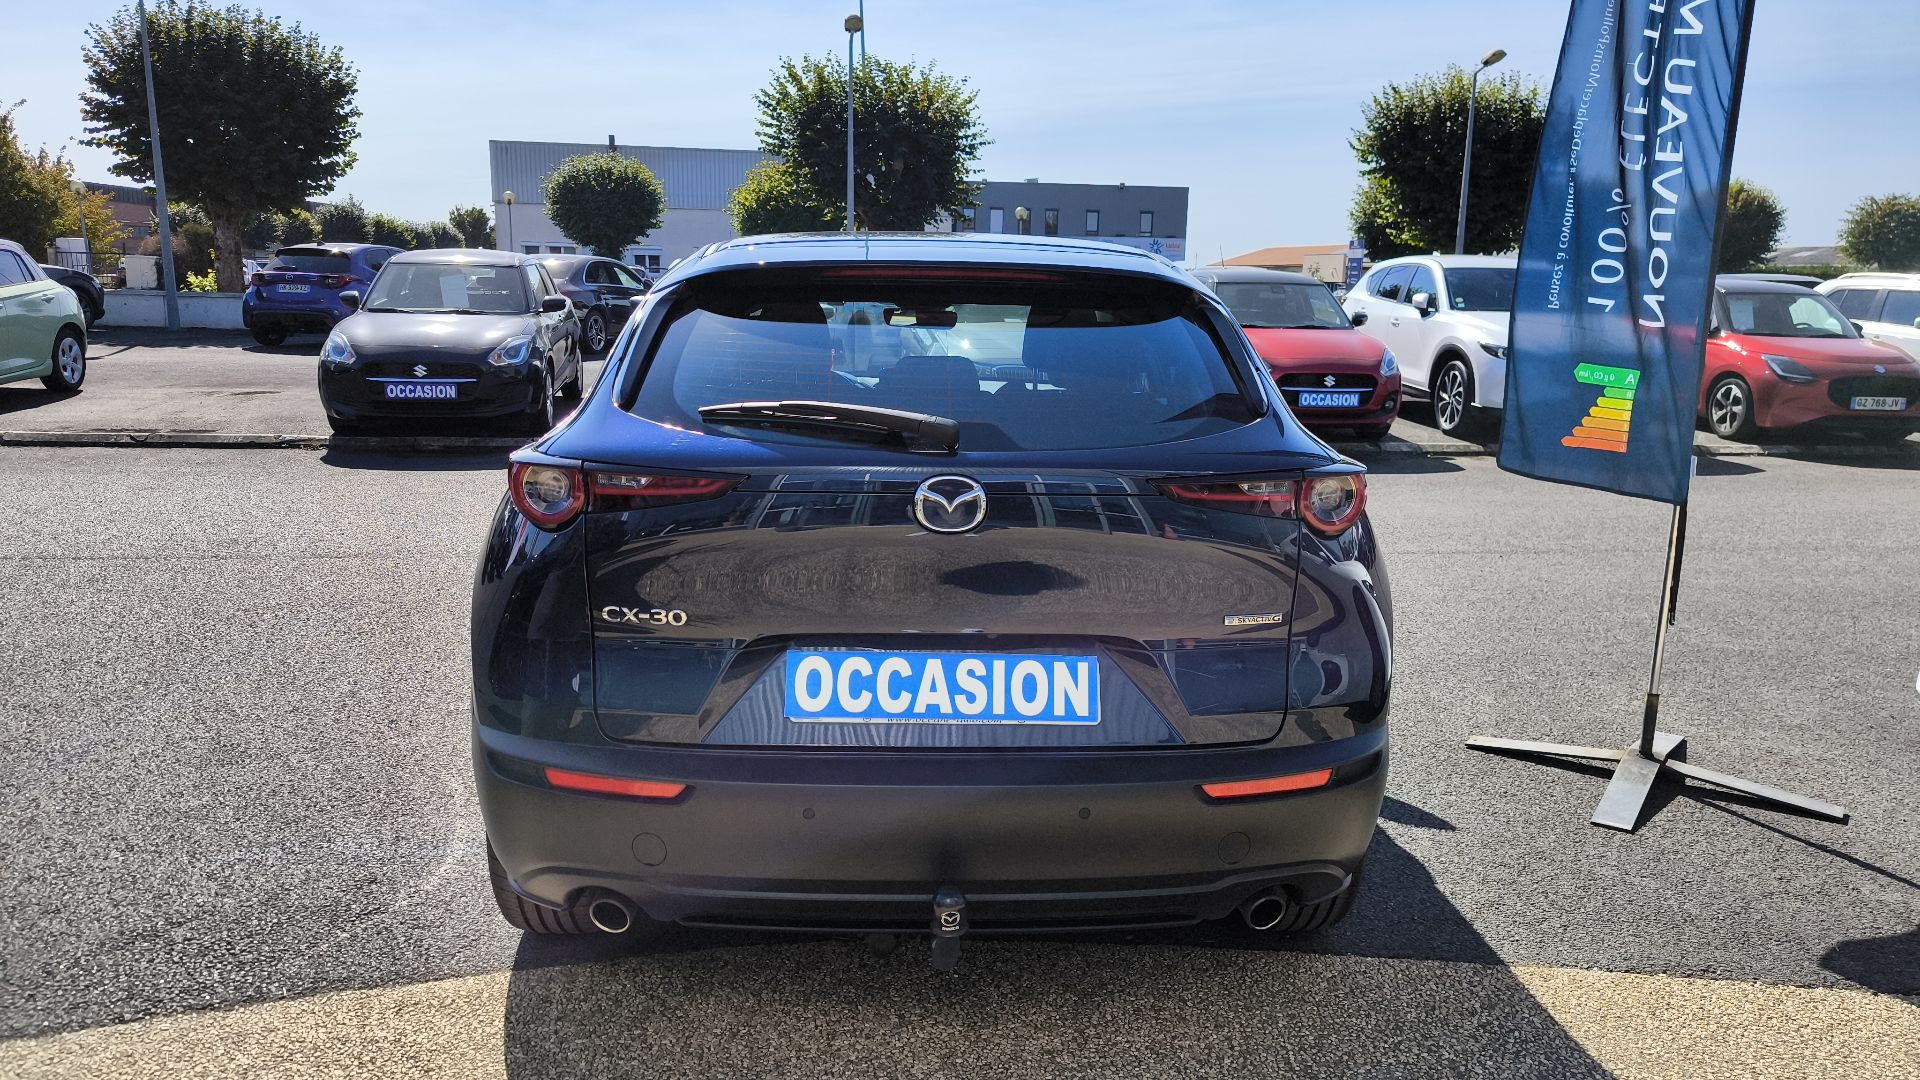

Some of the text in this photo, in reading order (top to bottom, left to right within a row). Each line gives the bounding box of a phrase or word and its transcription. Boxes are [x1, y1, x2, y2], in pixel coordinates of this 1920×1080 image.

[387, 384, 456, 398] OCCASION
[1301, 393, 1358, 406] OCCASION
[601, 605, 688, 626] CX-30
[794, 655, 1089, 717] OCCASION
